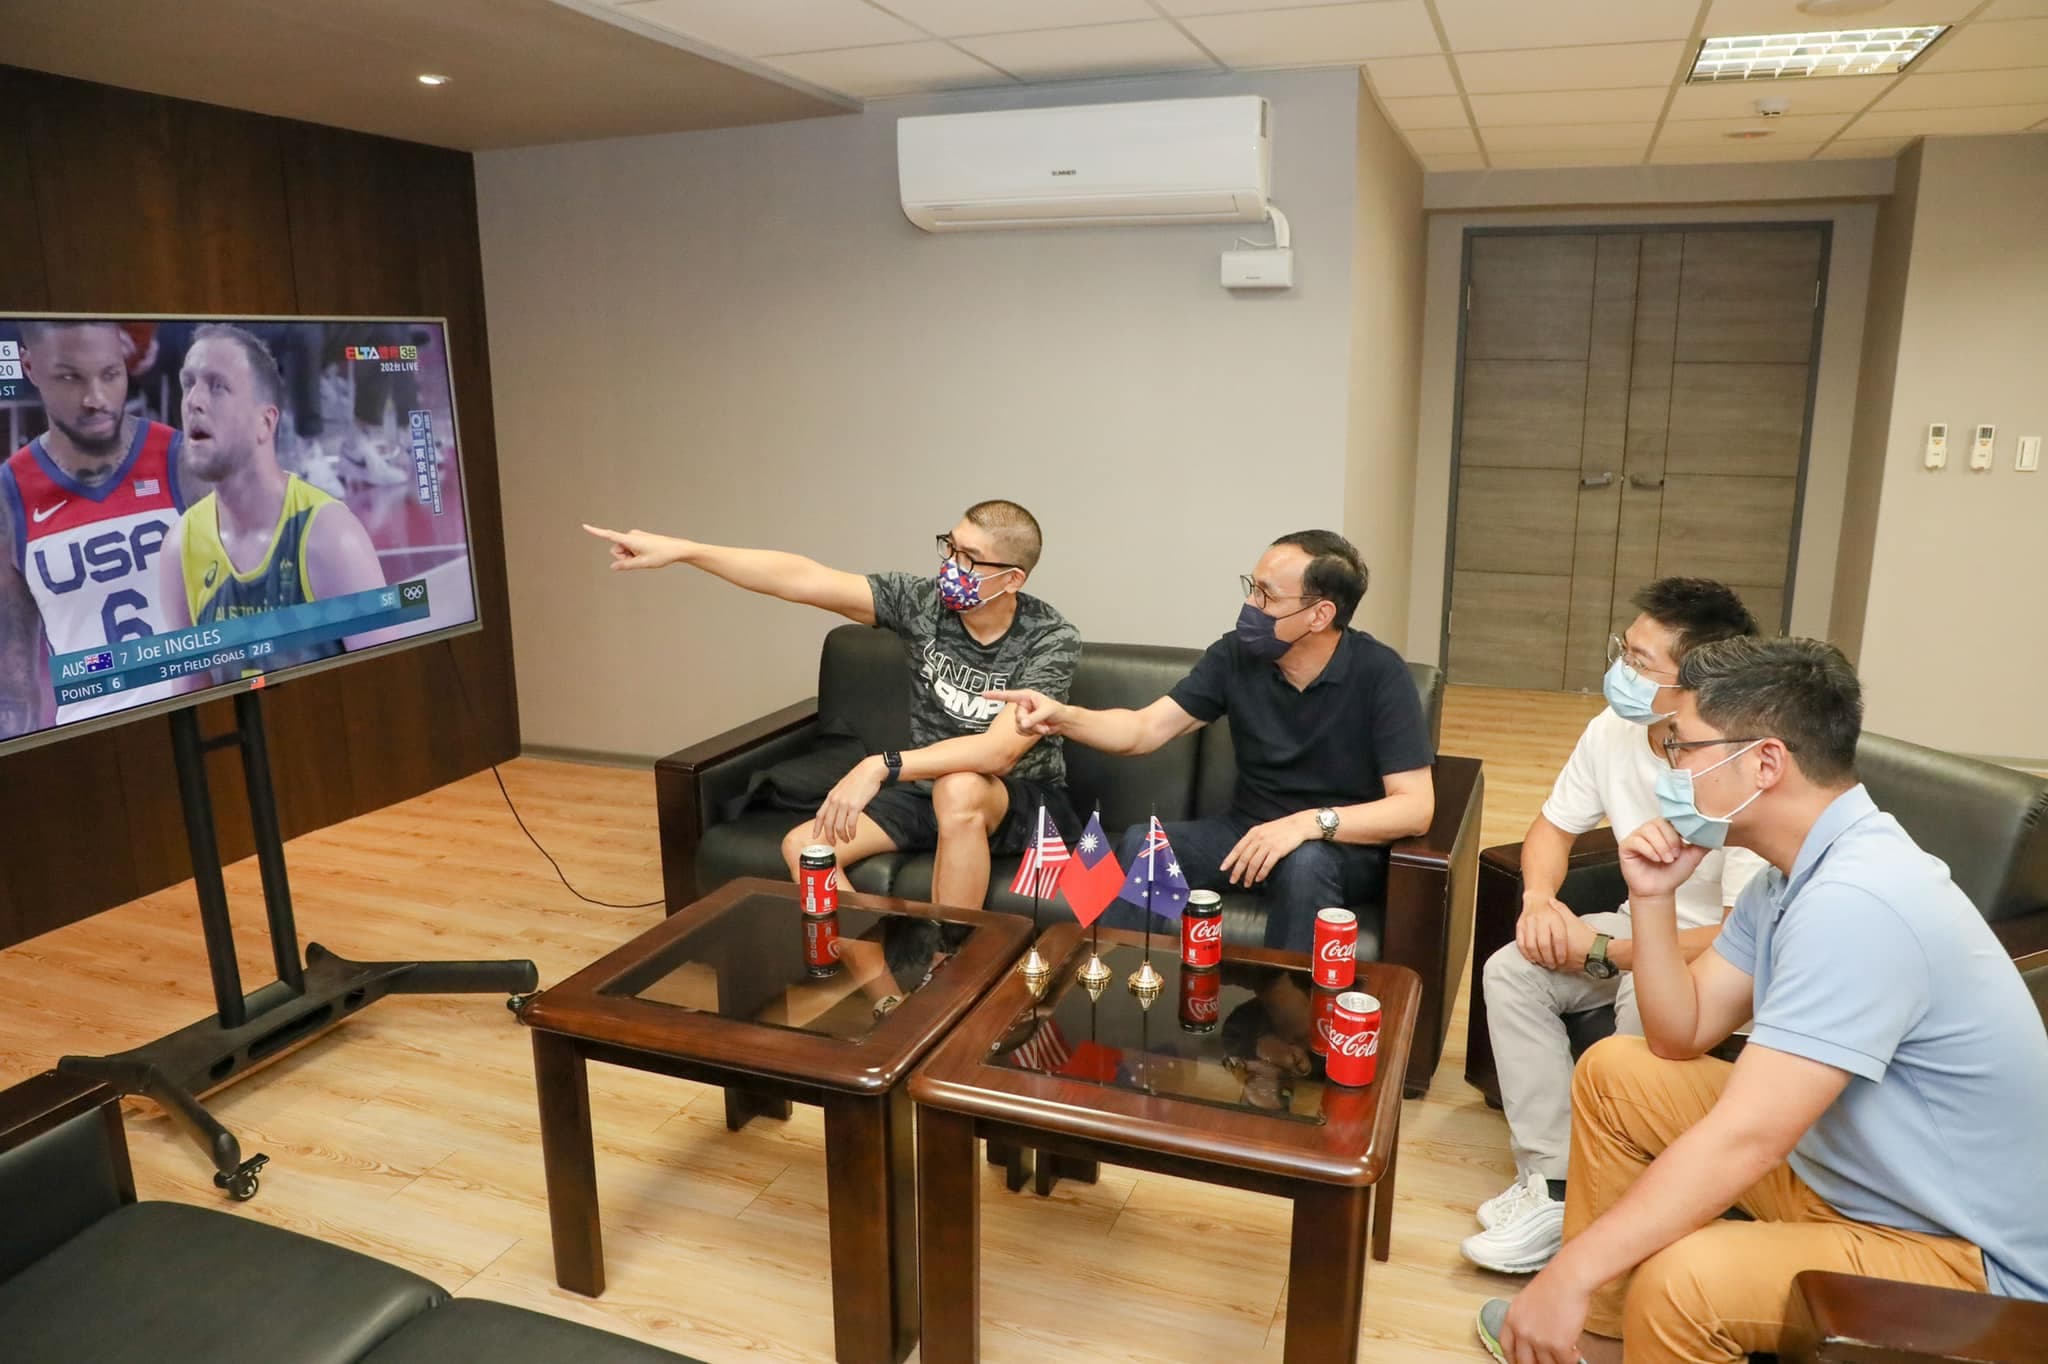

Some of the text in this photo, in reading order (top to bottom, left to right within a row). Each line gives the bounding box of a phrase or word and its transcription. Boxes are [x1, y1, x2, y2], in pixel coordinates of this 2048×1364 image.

[3, 345, 11, 356] 6
[401, 362, 418, 371] LIVE
[0, 385, 16, 397] ST
[101, 589, 154, 645] 6
[61, 661, 86, 679] AUS
[119, 652, 128, 665] 7
[164, 628, 222, 656] INGLES
[61, 682, 103, 701] POINTS
[112, 677, 121, 689] 6
[159, 666, 167, 679] 3
[184, 657, 211, 673] FIELD
[212, 649, 245, 665] GOALS
[252, 642, 271, 656] 2/3
